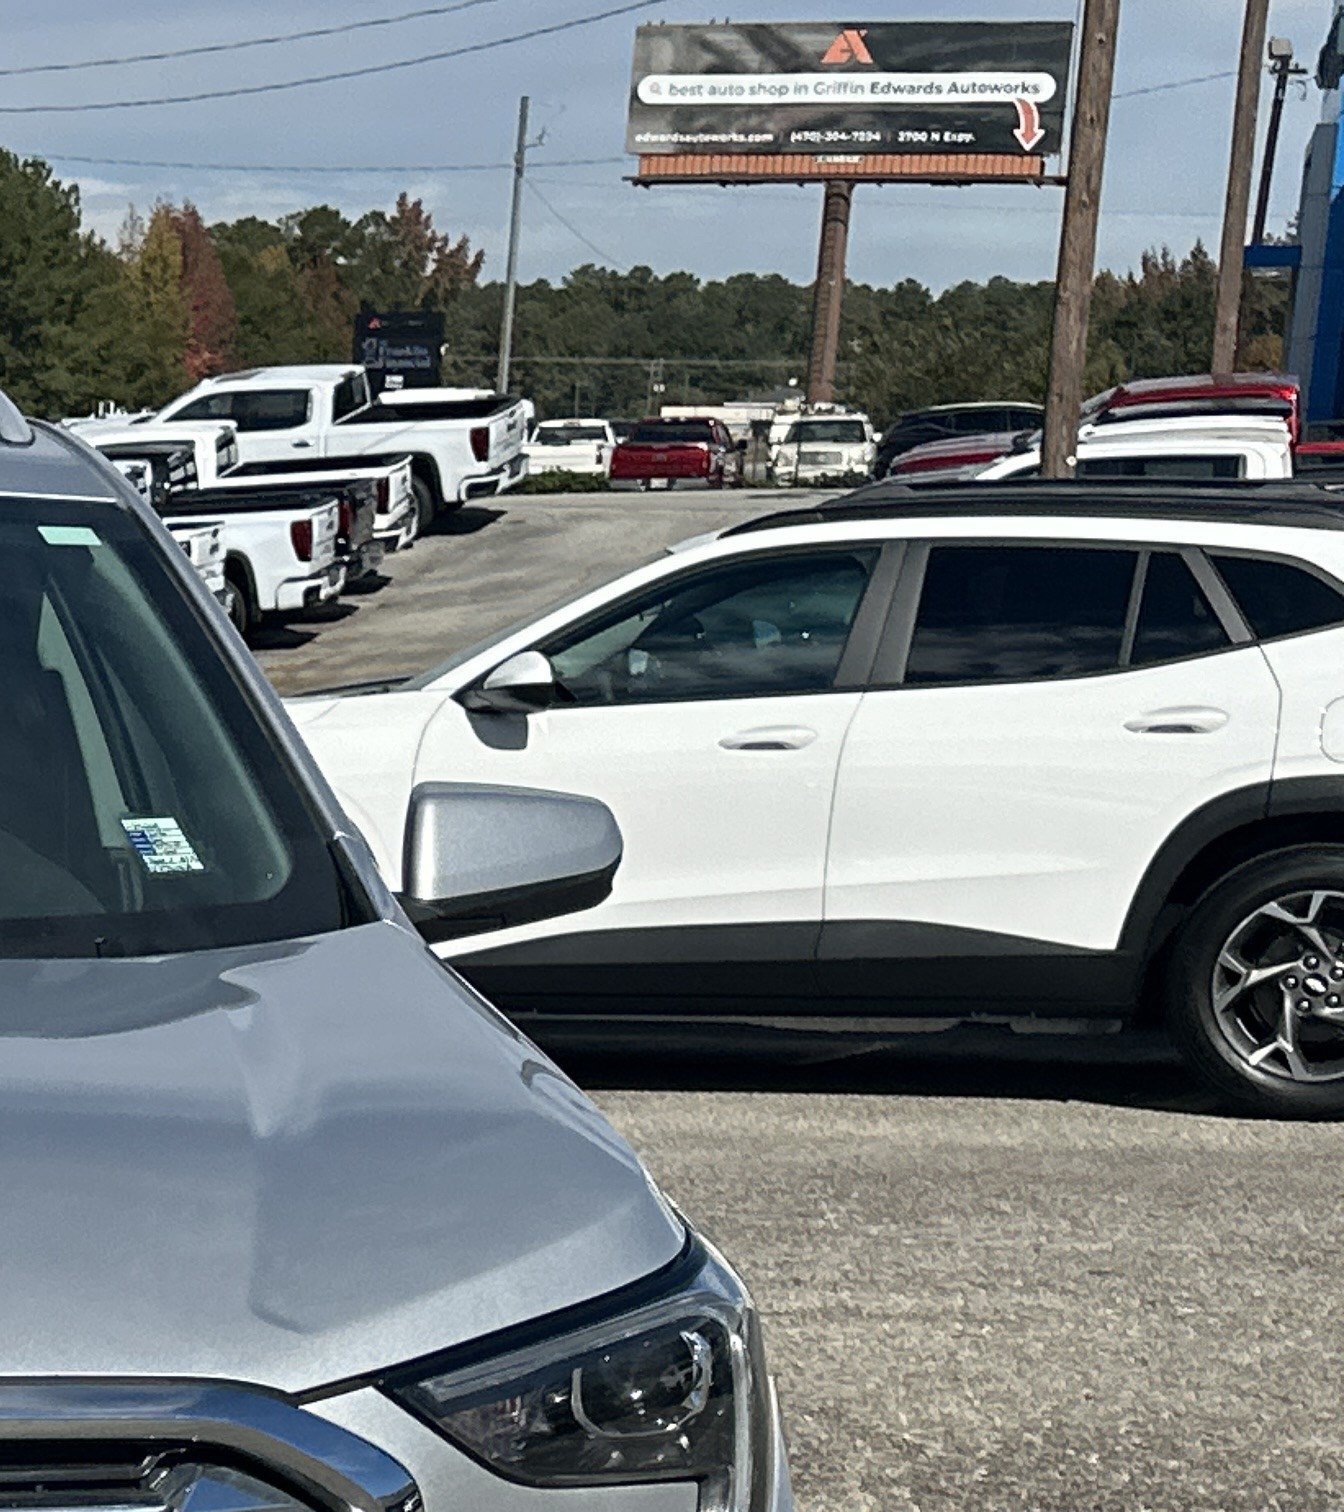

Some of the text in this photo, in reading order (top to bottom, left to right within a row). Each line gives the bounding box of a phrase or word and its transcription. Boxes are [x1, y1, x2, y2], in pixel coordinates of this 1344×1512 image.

[668, 80, 1042, 99] best auto shop in Griffin Edwards Autoworks
